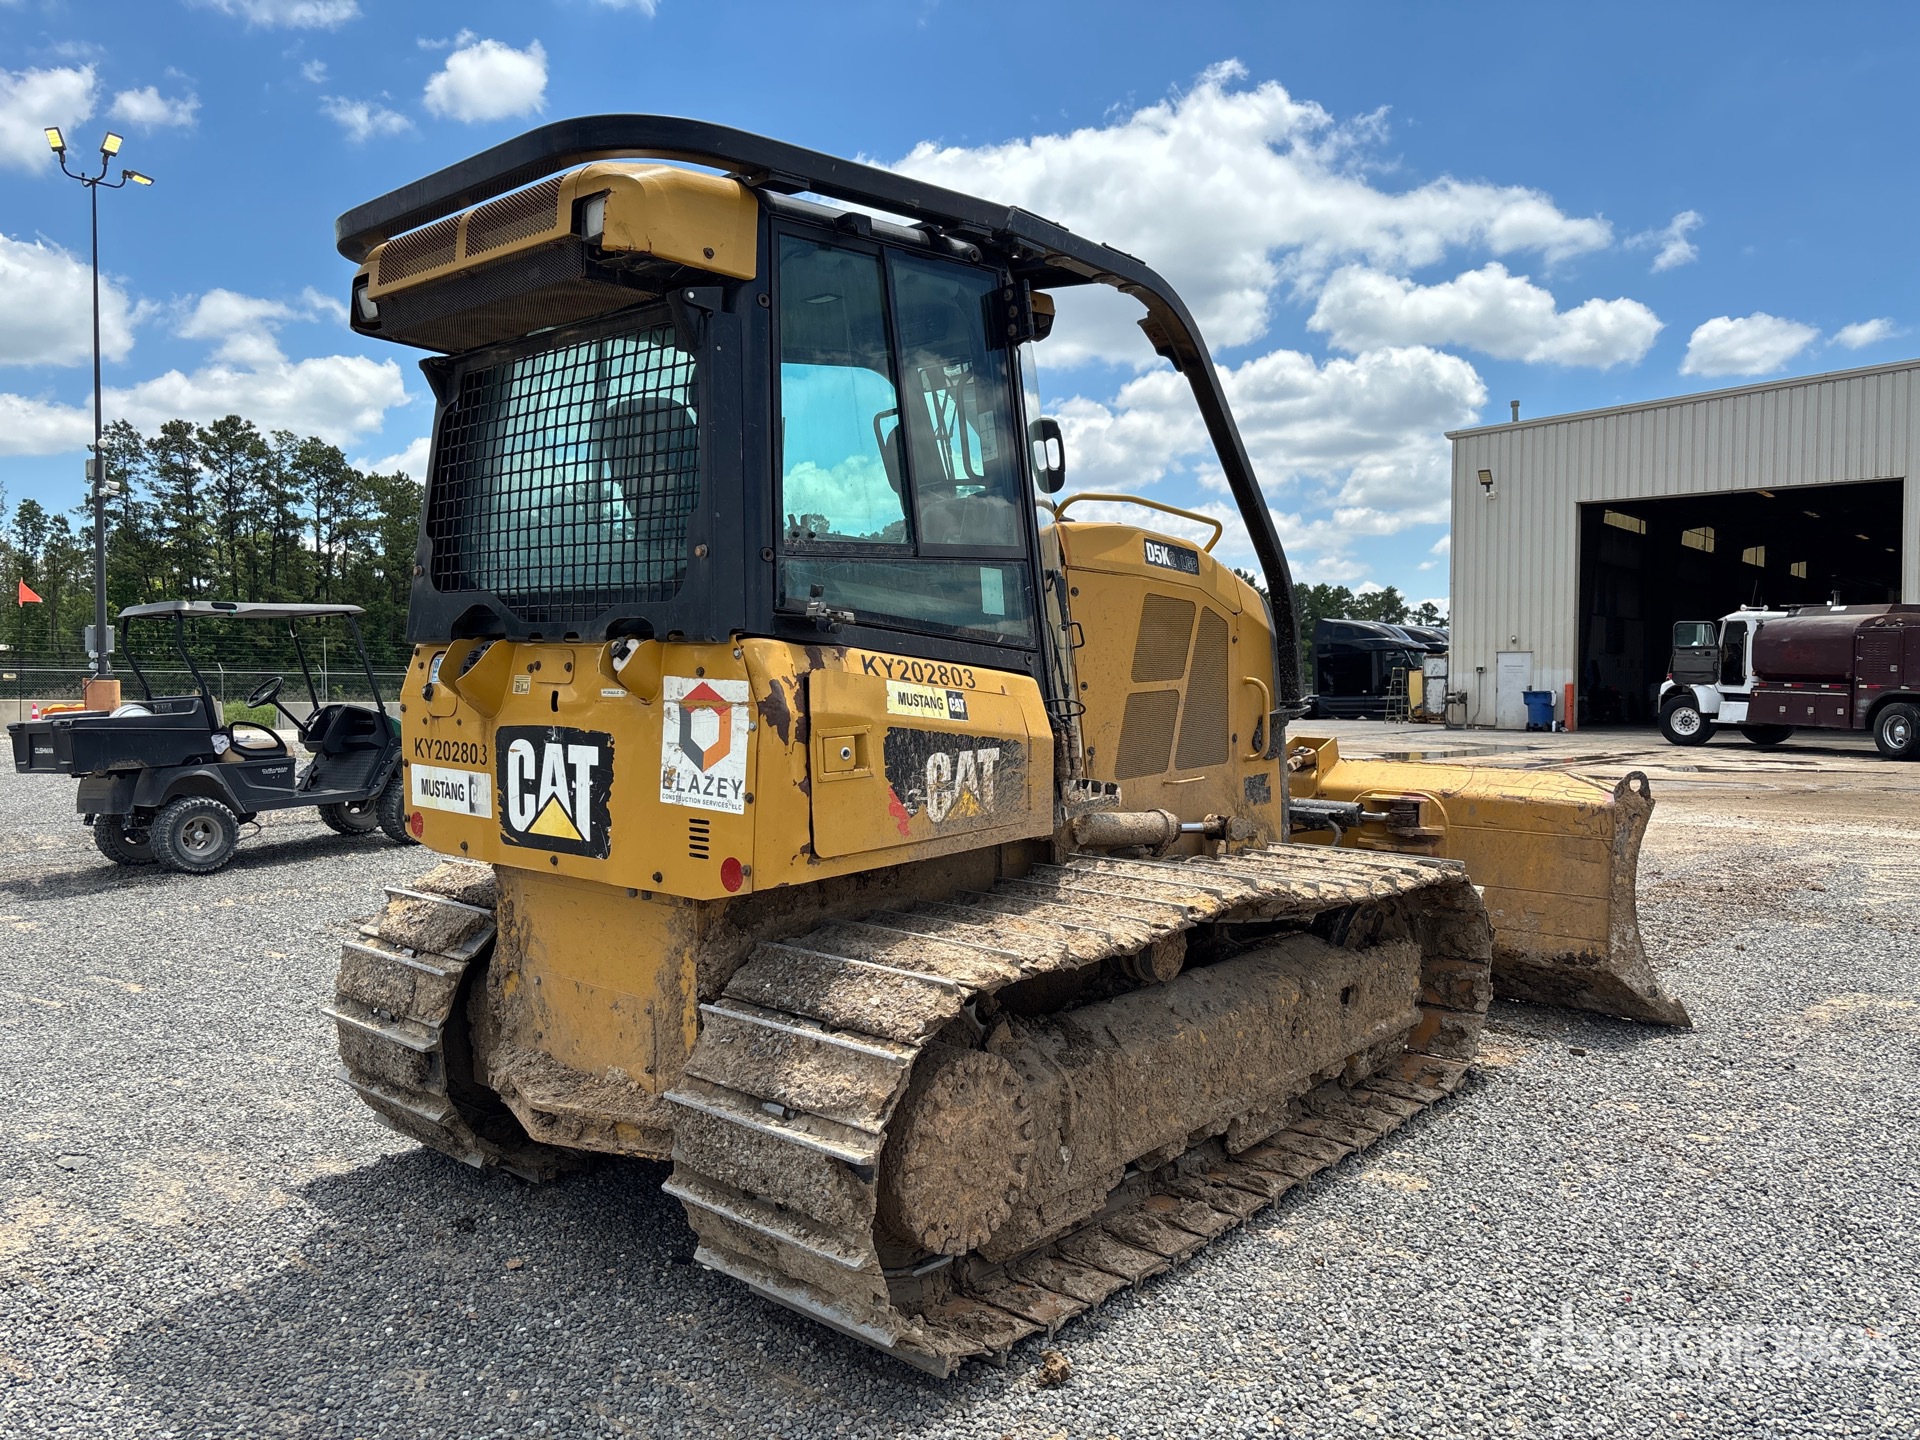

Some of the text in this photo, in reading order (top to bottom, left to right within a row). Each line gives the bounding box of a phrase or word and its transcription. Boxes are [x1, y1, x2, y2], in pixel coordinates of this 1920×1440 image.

[861, 654, 976, 689] KY202803
[897, 691, 965, 713] MUSTANG CAT
[414, 737, 488, 766] KY202803
[421, 778, 465, 802] MUSTANG
[507, 738, 600, 842] CAT
[926, 747, 1000, 823] CAT
